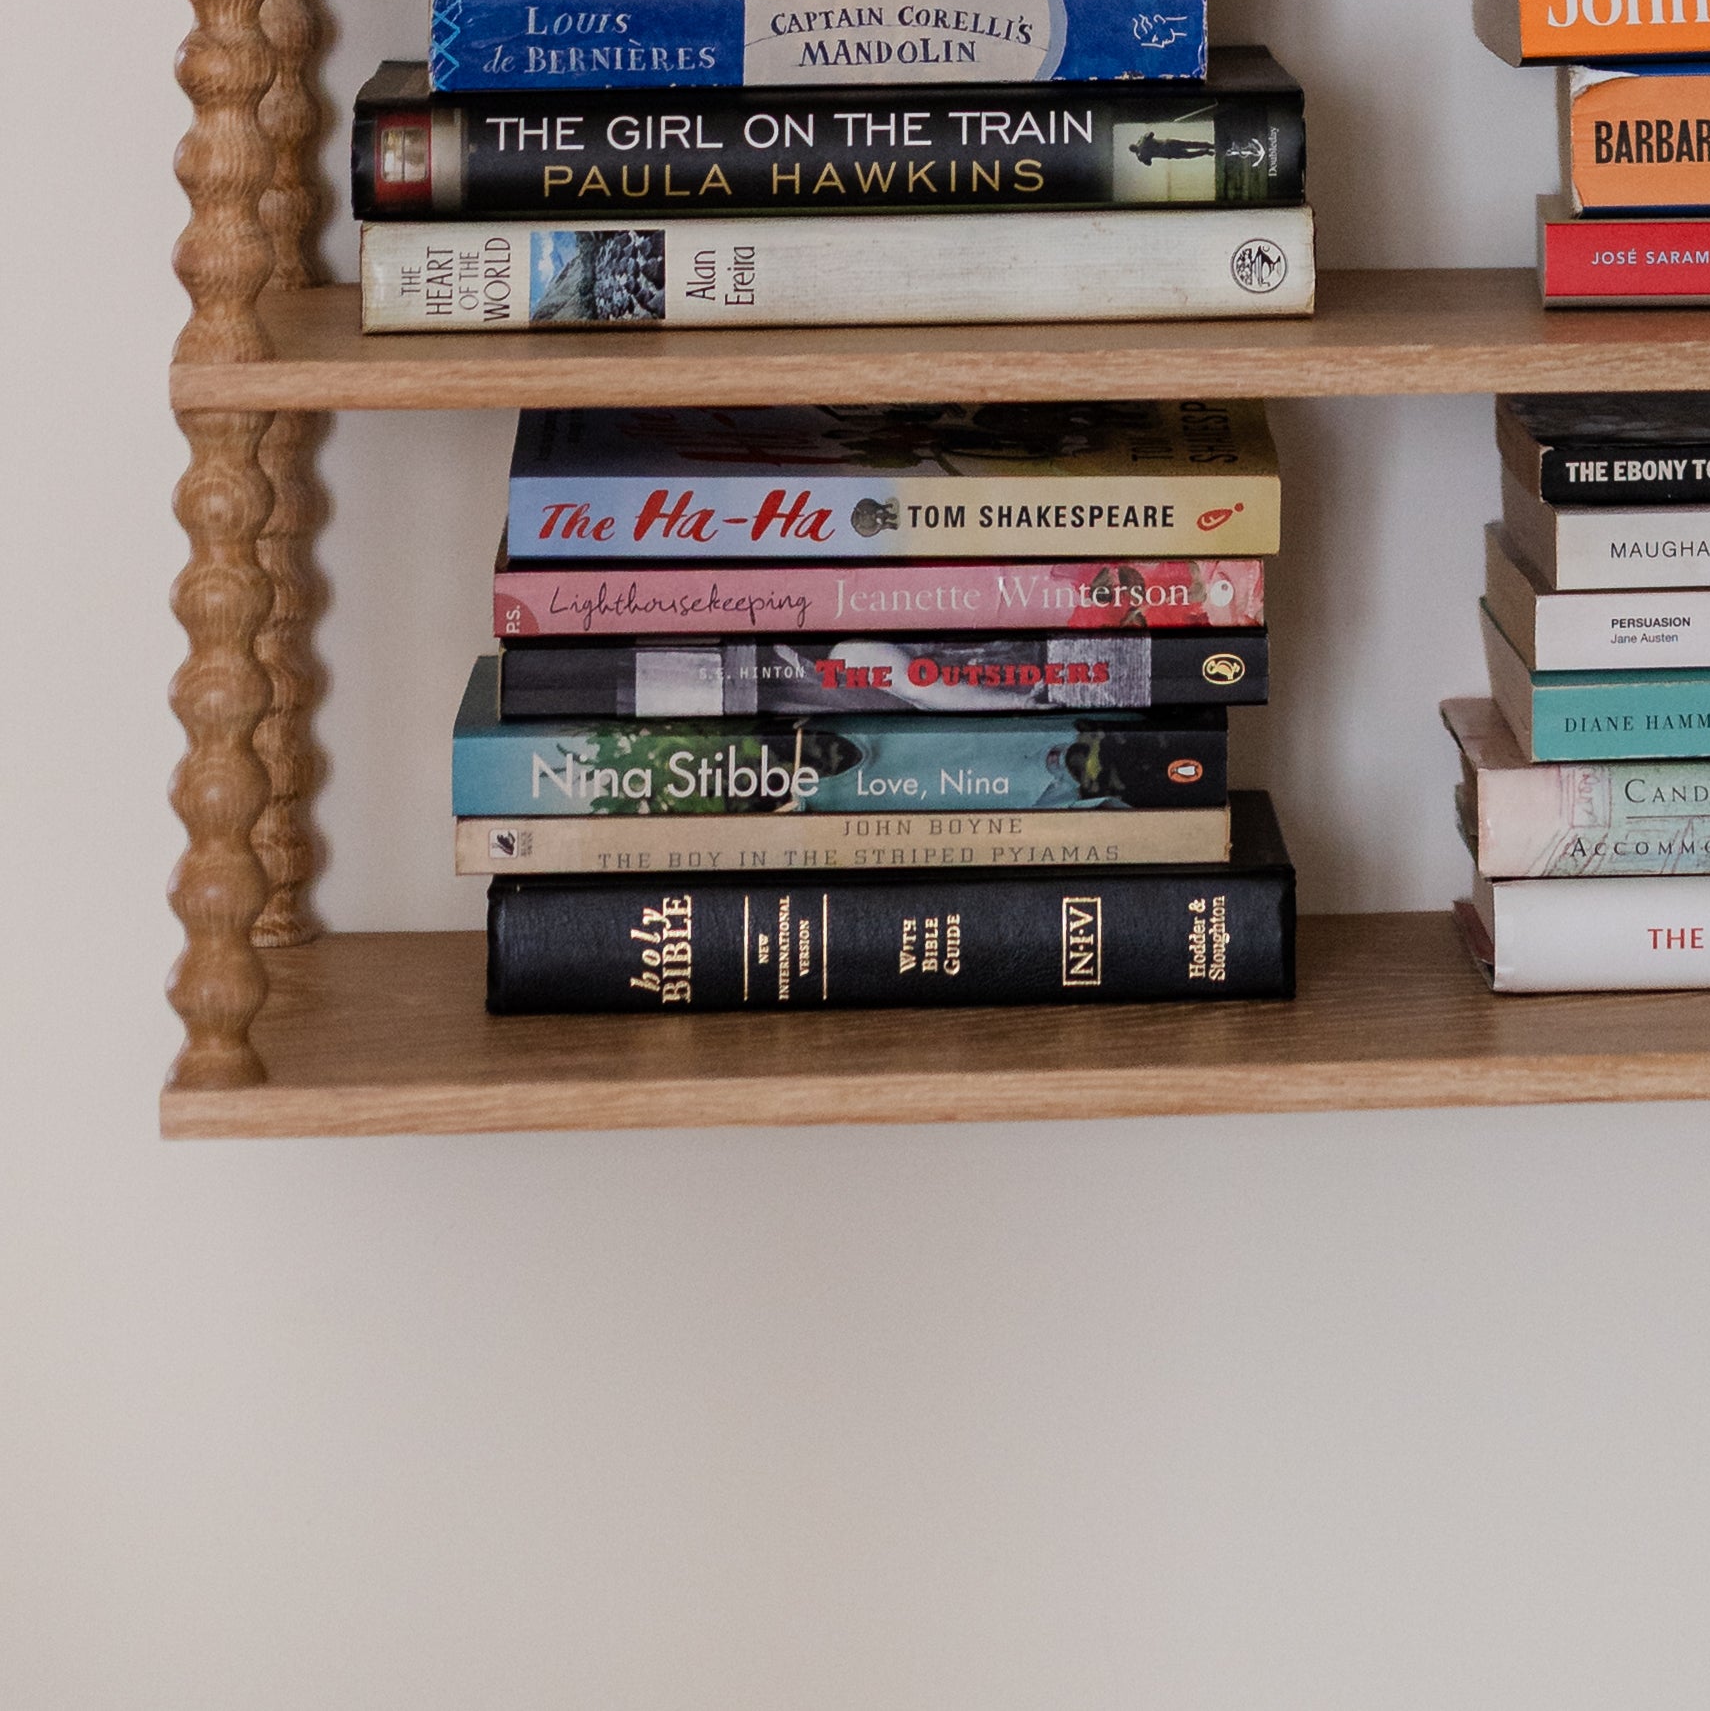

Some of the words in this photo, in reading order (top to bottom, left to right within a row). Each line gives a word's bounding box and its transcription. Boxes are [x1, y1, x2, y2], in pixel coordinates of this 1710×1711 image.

[770, 5, 884, 36] CAPTAIN
[899, 4, 1033, 46] CORELLI'S
[524, 39, 717, 74] BERNIÈRES
[801, 38, 976, 67] MANDOLIN
[485, 117, 585, 152] THE
[606, 115, 724, 151] GIRL
[743, 113, 815, 149] ON
[834, 112, 932, 147] THE
[948, 110, 1092, 146] TRAIN
[543, 164, 734, 197] PAULA
[771, 159, 1045, 195] HAWKINS
[401, 266, 422, 297] THE
[426, 246, 453, 316] HEART
[484, 237, 512, 322] WORLD
[724, 245, 756, 307] Ereira
[1613, 459, 1688, 481] EBONY
[539, 503, 615, 541] The
[633, 489, 836, 542] Ha-Ha
[908, 505, 966, 528] TOM
[979, 504, 1175, 528] SHAKESPEARE
[550, 582, 812, 630] Lighthousekeeping
[997, 575, 1190, 609] Winterson
[1611, 616, 1691, 629] PERSUASION
[740, 665, 805, 680] HINTON
[815, 659, 892, 689] THE
[907, 657, 1109, 687] OUTSIDERS
[1564, 715, 1634, 734] DIANE
[531, 752, 652, 799] Nina
[668, 744, 819, 799] Stibbe
[940, 769, 1009, 796] Nina
[843, 820, 912, 837] JOHN
[930, 818, 1023, 836] BOYNE
[598, 853, 651, 869] THE
[669, 852, 722, 869] BOY
[784, 850, 838, 867] THE
[855, 848, 974, 866] STRIPED
[992, 845, 1119, 863] PYJAMAS
[1209, 895, 1230, 982] Stoughton
[1647, 927, 1705, 950] THE
